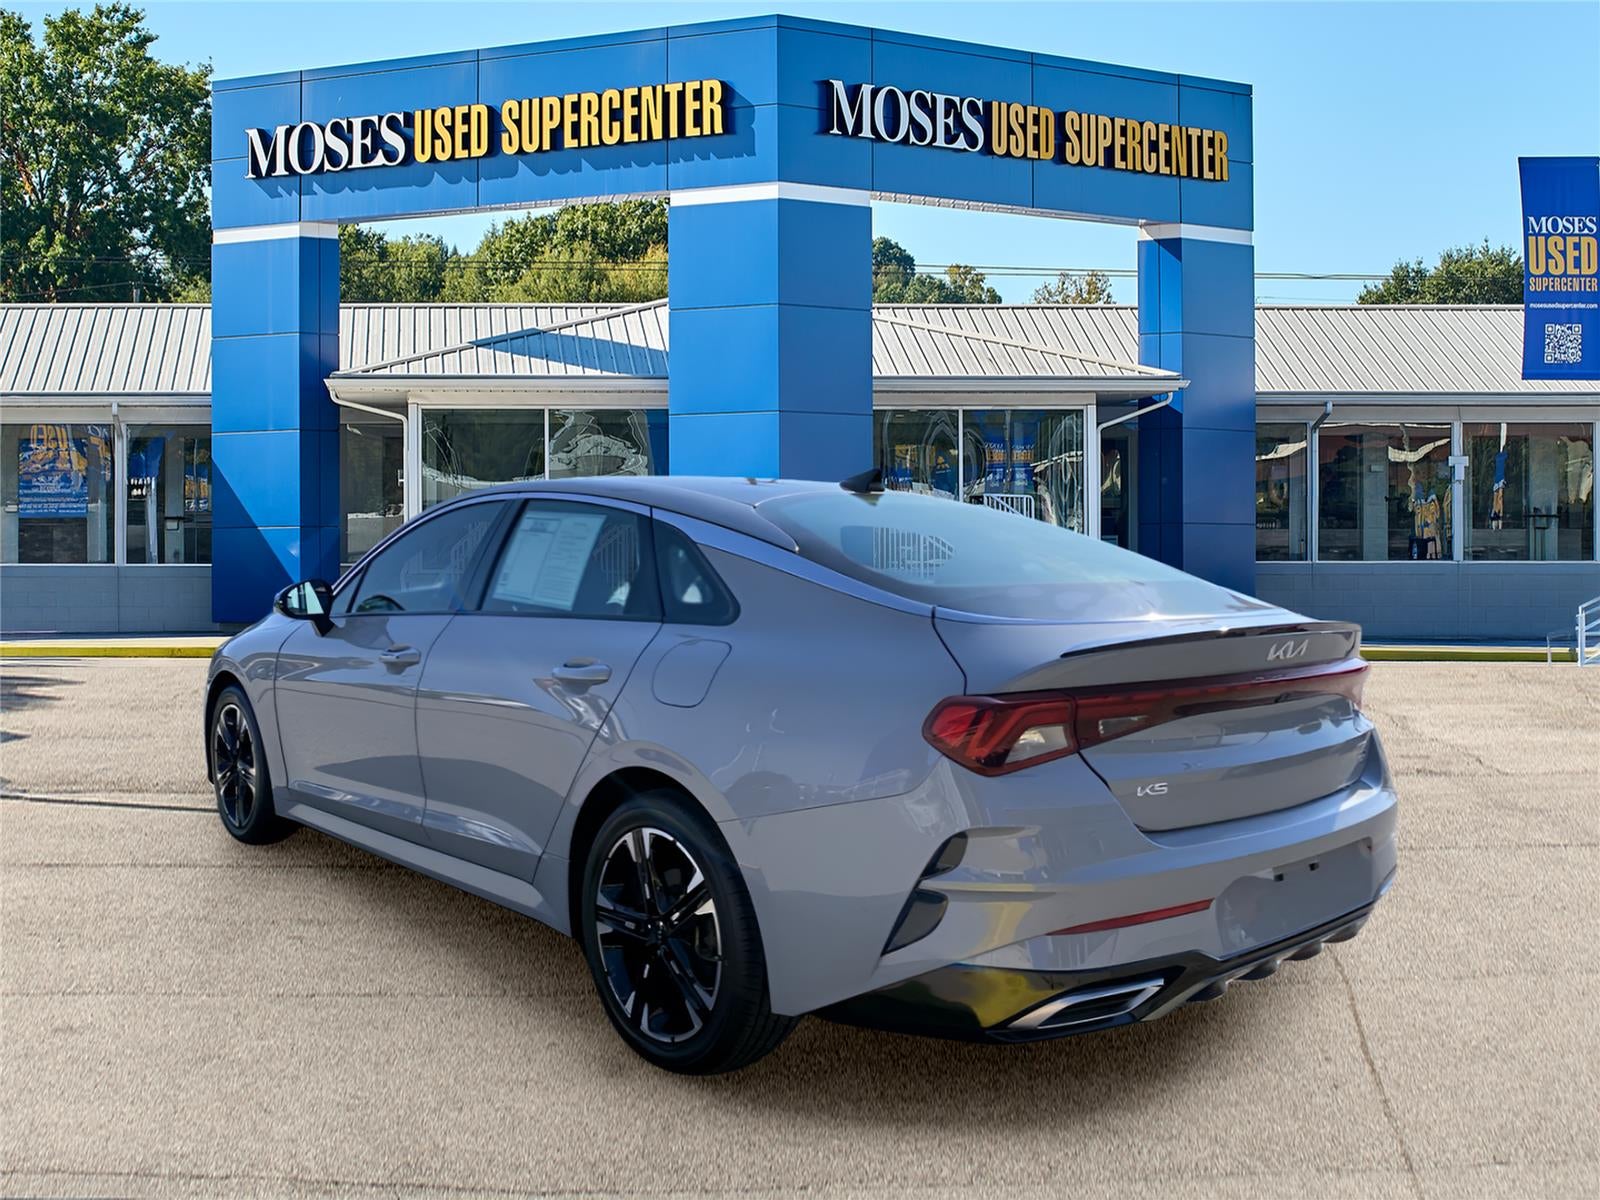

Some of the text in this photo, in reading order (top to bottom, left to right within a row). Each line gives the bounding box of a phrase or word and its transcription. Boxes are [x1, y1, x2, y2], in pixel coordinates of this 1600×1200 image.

[245, 79, 724, 179] MOSES USED SUPERCENTER
[828, 79, 1229, 182] MOSES USED SUPERCENTER
[1528, 216, 1597, 234] MOSES
[1528, 235, 1598, 276] USED
[1529, 277, 1598, 292] SUPERCENTER
